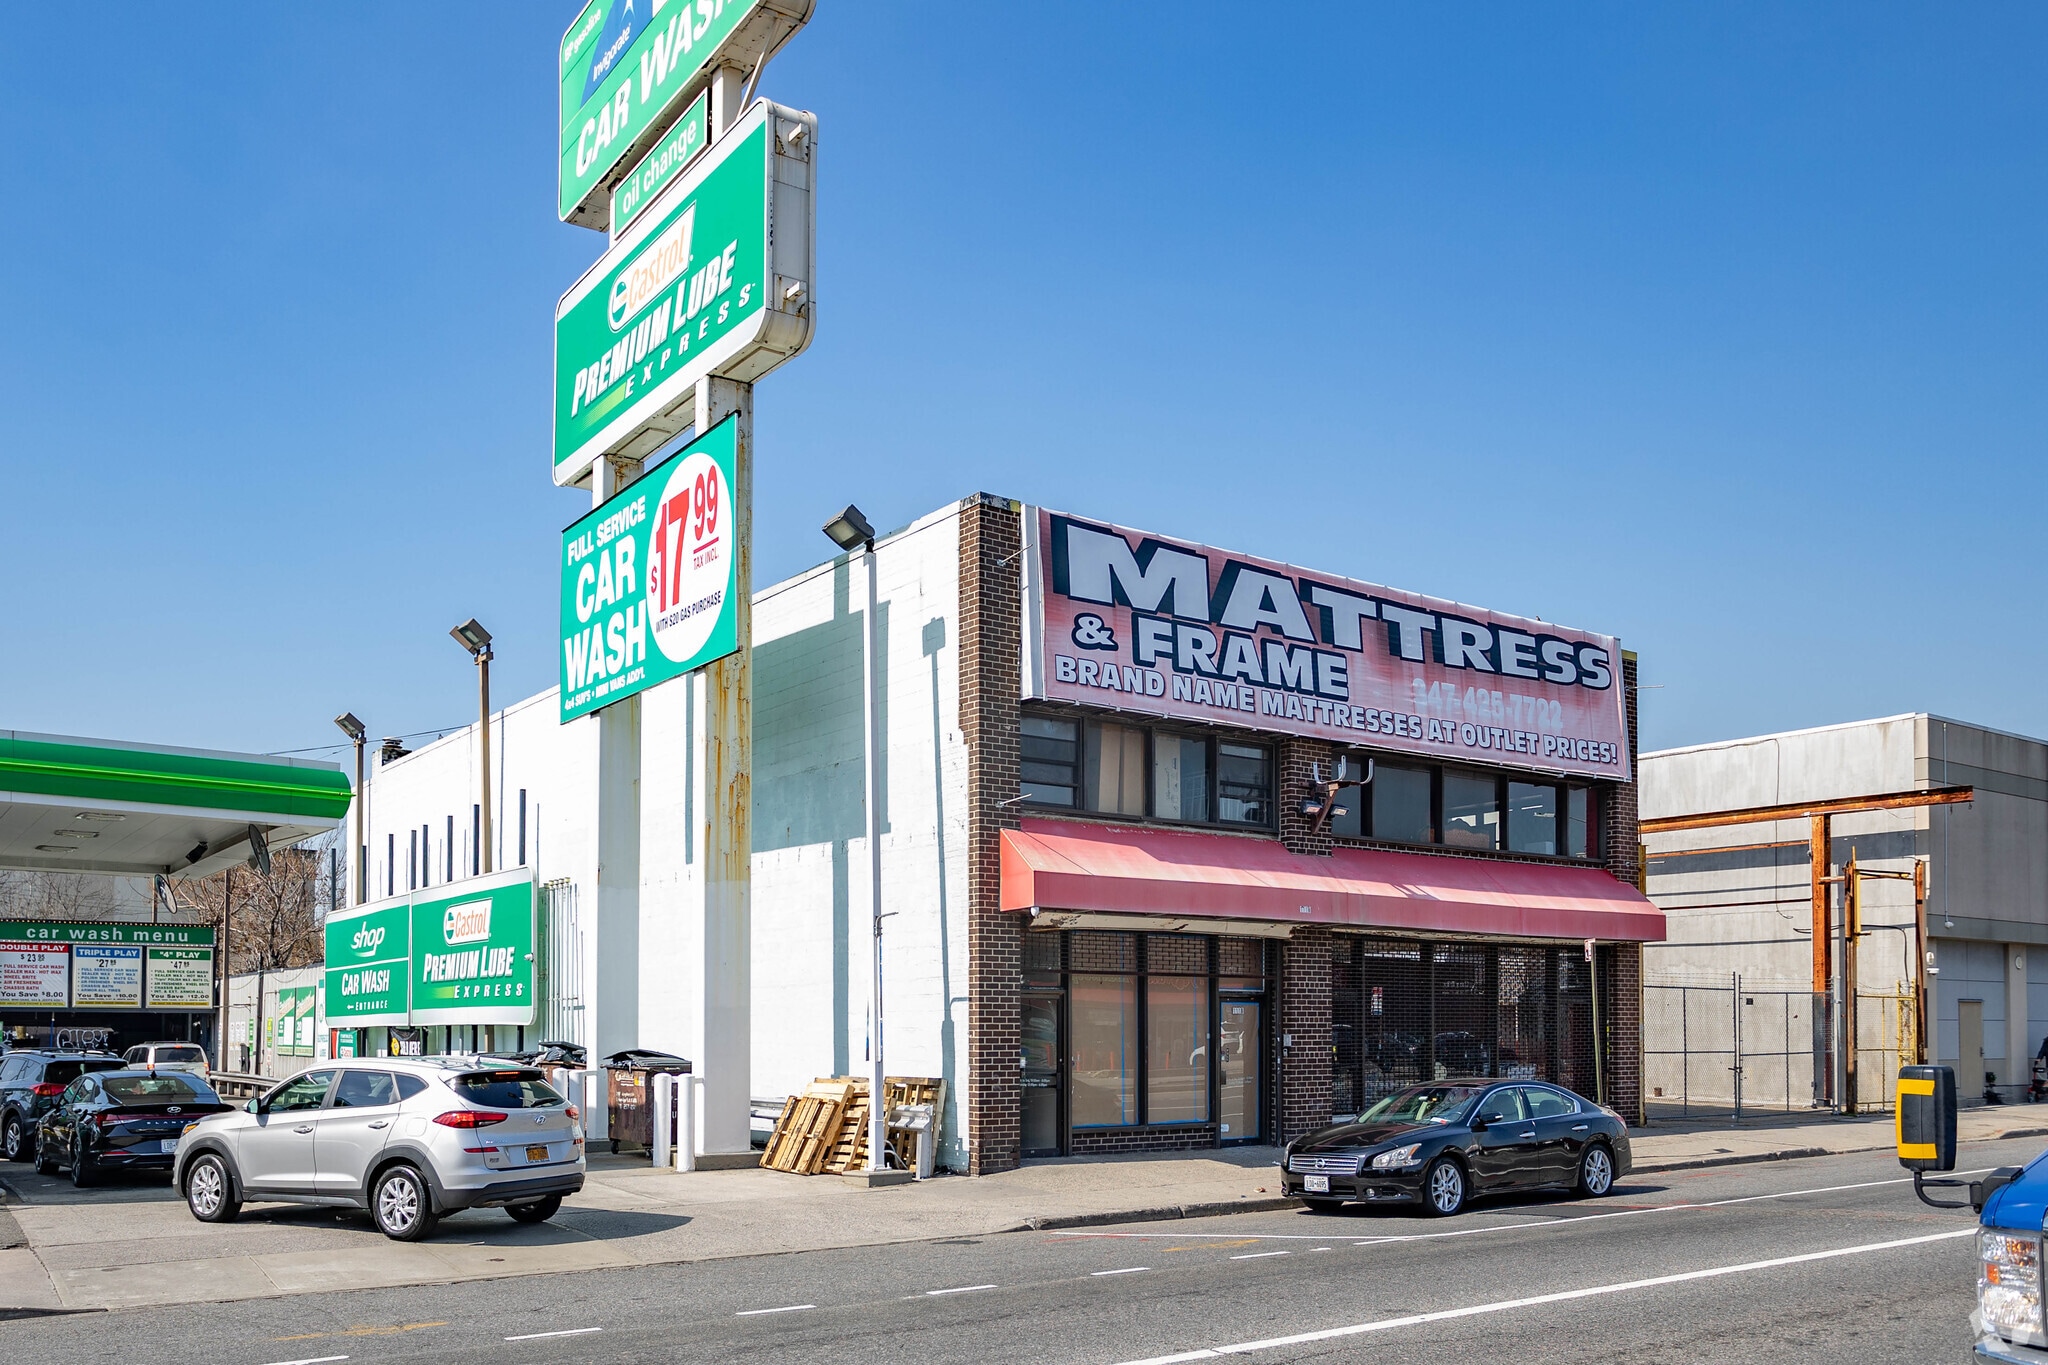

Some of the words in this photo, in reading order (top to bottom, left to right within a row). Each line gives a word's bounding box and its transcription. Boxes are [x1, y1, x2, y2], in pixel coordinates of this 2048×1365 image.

[573, 9, 602, 53] gasoline
[593, 25, 631, 82] Invigorate
[576, 78, 631, 178] CAR
[622, 173, 640, 214] oil
[643, 120, 697, 192] change
[628, 224, 686, 309] Castrol
[571, 296, 672, 418] PREMIUM
[672, 238, 738, 334] LUBE
[624, 284, 751, 398] EXPRESS
[567, 530, 594, 566] FULL
[596, 495, 646, 548] SERVICE
[694, 554, 704, 570] TAX
[576, 534, 636, 623] CAR
[1055, 516, 1612, 690] MATTRESS
[656, 617, 668, 633] WITH
[680, 605, 690, 621] GAS
[692, 590, 721, 616] PURCHASE
[564, 598, 646, 693] WASH
[1072, 612, 1118, 651] &
[1132, 612, 1348, 701] FRAME
[1054, 653, 1165, 697] BRAND
[1172, 673, 1255, 713] NAME
[1261, 689, 1422, 739] MATTRESSES
[1427, 718, 1456, 743] AT
[1460, 721, 1538, 755] OUTLET
[1542, 733, 1618, 765] PRICES!
[26, 928, 59, 939] car
[69, 928, 123, 940] wash
[133, 930, 188, 942] menu
[351, 921, 385, 954] shop
[455, 907, 487, 938] Castrol
[341, 973, 358, 996] CAR
[361, 969, 390, 994] WASH
[423, 951, 479, 983] PREMIUM
[480, 946, 515, 979] LUBE
[454, 983, 523, 999] EXPRESS
[355, 1000, 388, 1011] ENTRANCE
